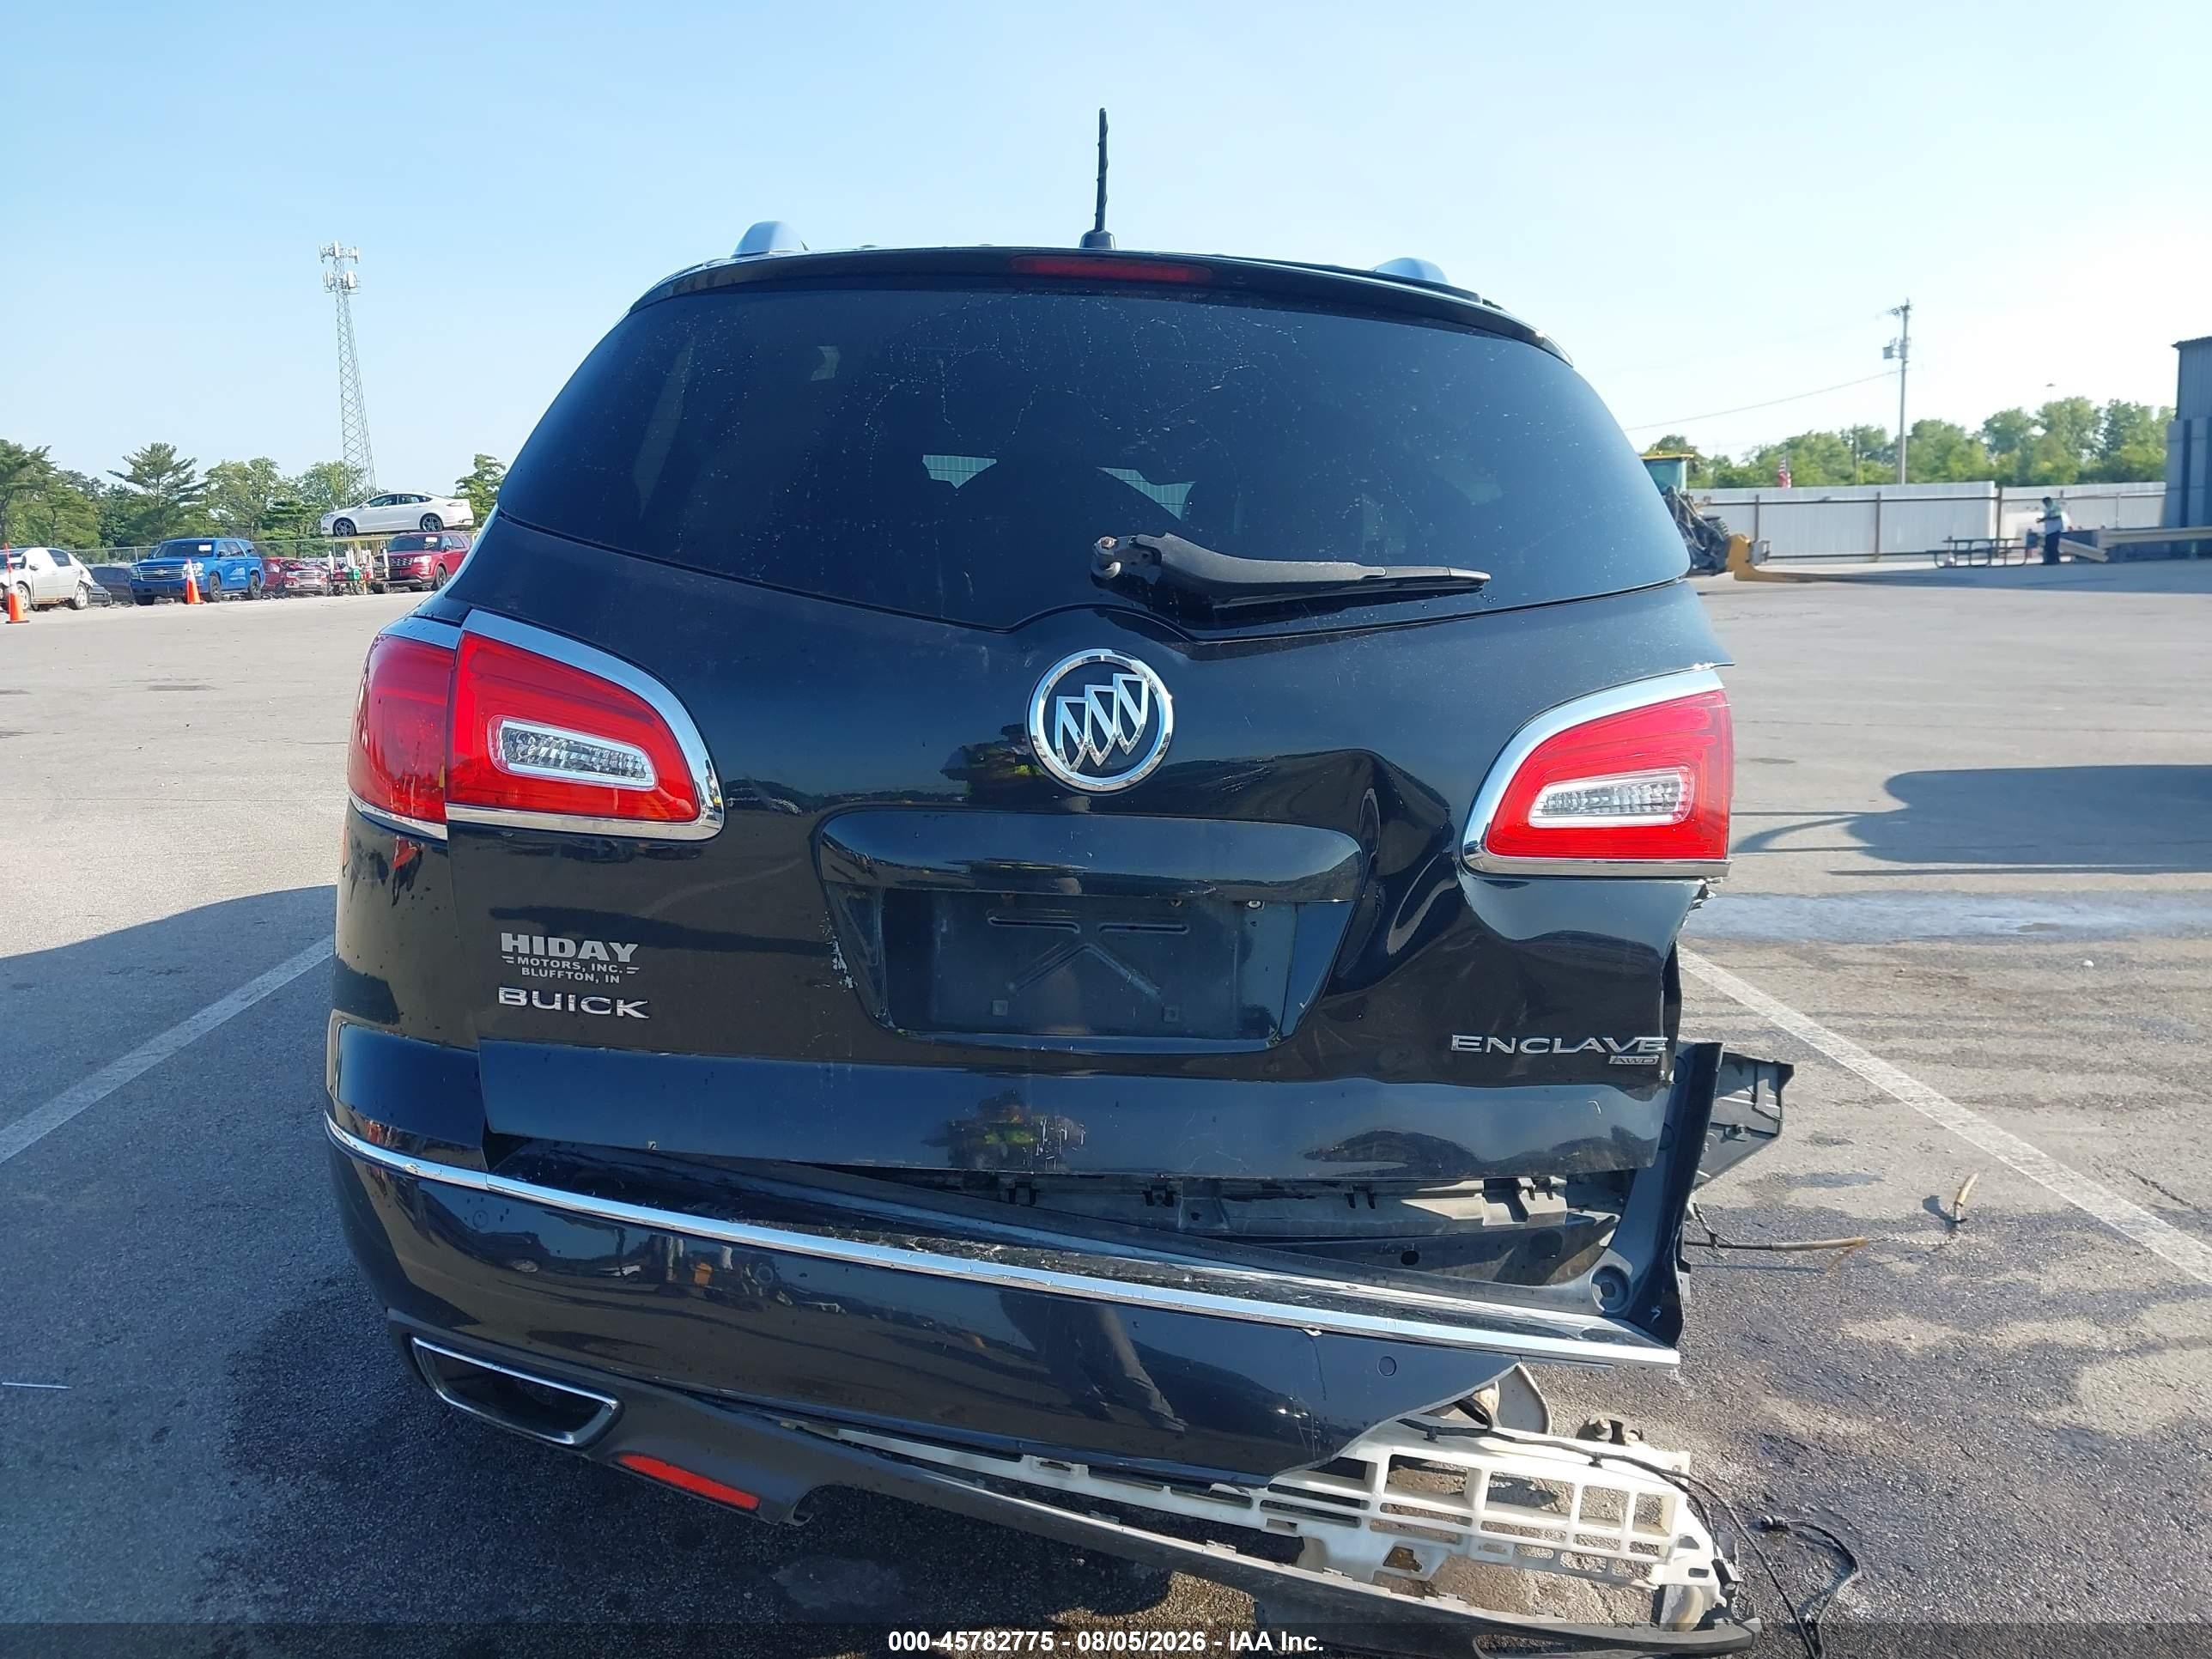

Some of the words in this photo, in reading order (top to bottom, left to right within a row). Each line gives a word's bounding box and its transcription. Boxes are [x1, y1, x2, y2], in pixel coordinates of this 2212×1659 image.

[501, 933, 638, 963] HIDAY
[517, 957, 586, 972] MOTORS,
[591, 963, 623, 974] INC.
[521, 967, 599, 983] BLUFFTON,
[605, 974, 620, 983] IN
[498, 987, 649, 1019] BUICK
[1451, 1035, 1668, 1054] ENCLAVE
